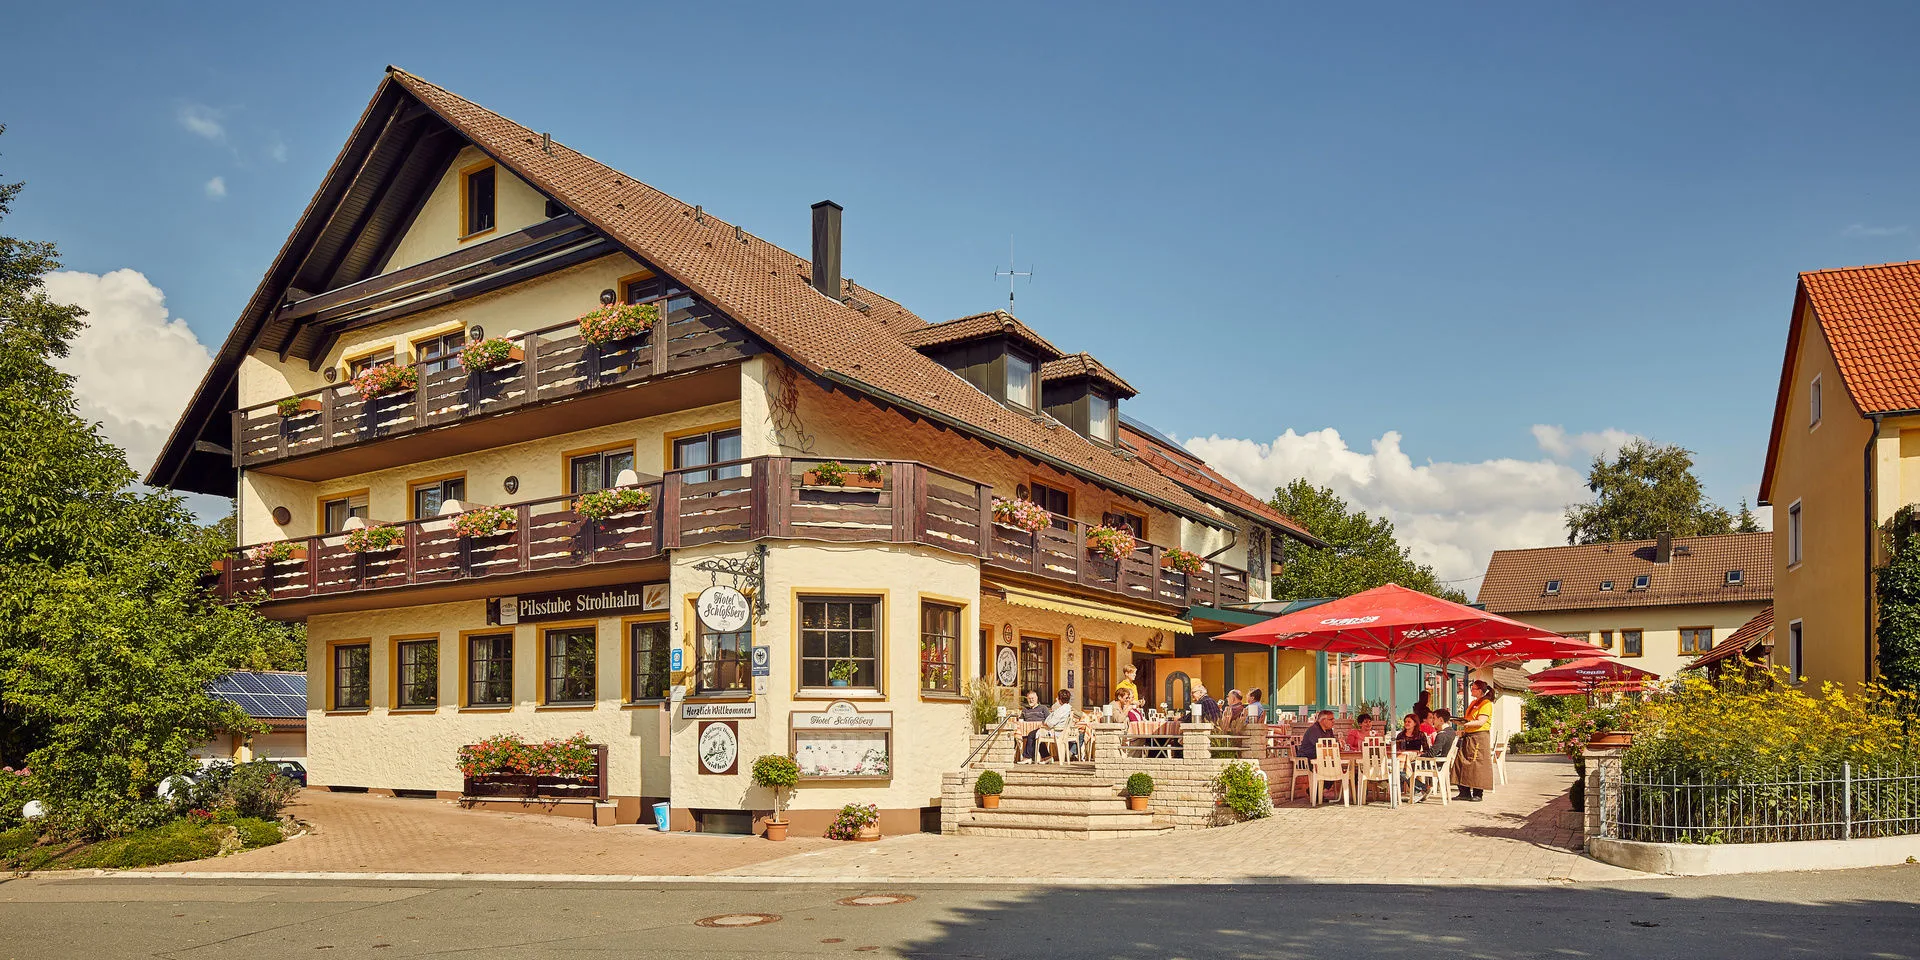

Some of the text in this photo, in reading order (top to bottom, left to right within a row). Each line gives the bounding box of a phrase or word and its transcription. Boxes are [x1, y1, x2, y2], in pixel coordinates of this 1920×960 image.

[519, 590, 640, 617] Pilsstube Strohhalm
[713, 591, 736, 605] Hotel
[704, 603, 745, 620] Schloßberg
[674, 622, 679, 631] 5
[686, 705, 752, 716] Herzlich Willkommen
[810, 715, 874, 726] Hotel Schloßberg
